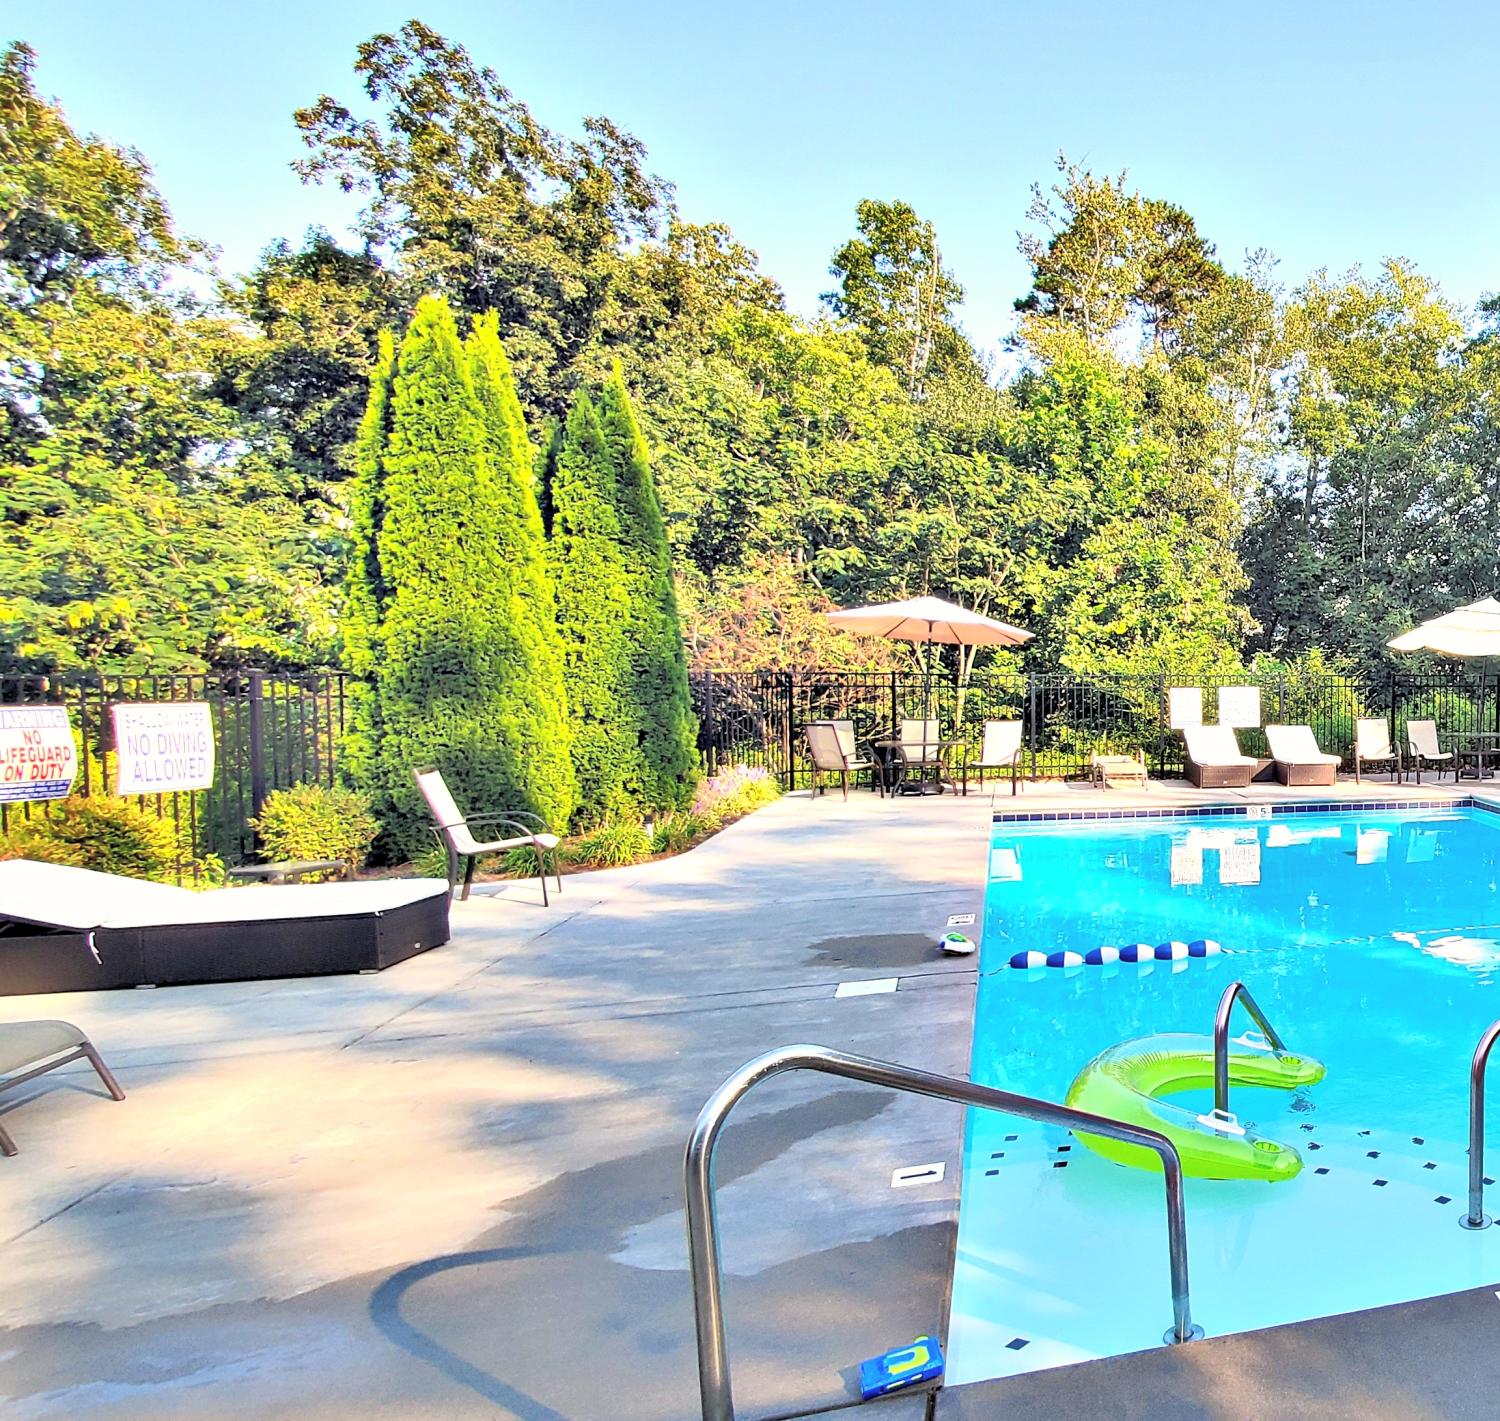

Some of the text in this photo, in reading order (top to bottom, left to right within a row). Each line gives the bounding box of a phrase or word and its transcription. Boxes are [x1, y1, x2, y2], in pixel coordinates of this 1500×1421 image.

[0, 710, 66, 728] ARNING
[22, 729, 41, 746] NO
[127, 731, 206, 756] NO DIVING
[0, 745, 71, 764] LIFEGUARD
[4, 763, 65, 781] ON DUTY
[132, 757, 206, 782] ALLOWED
